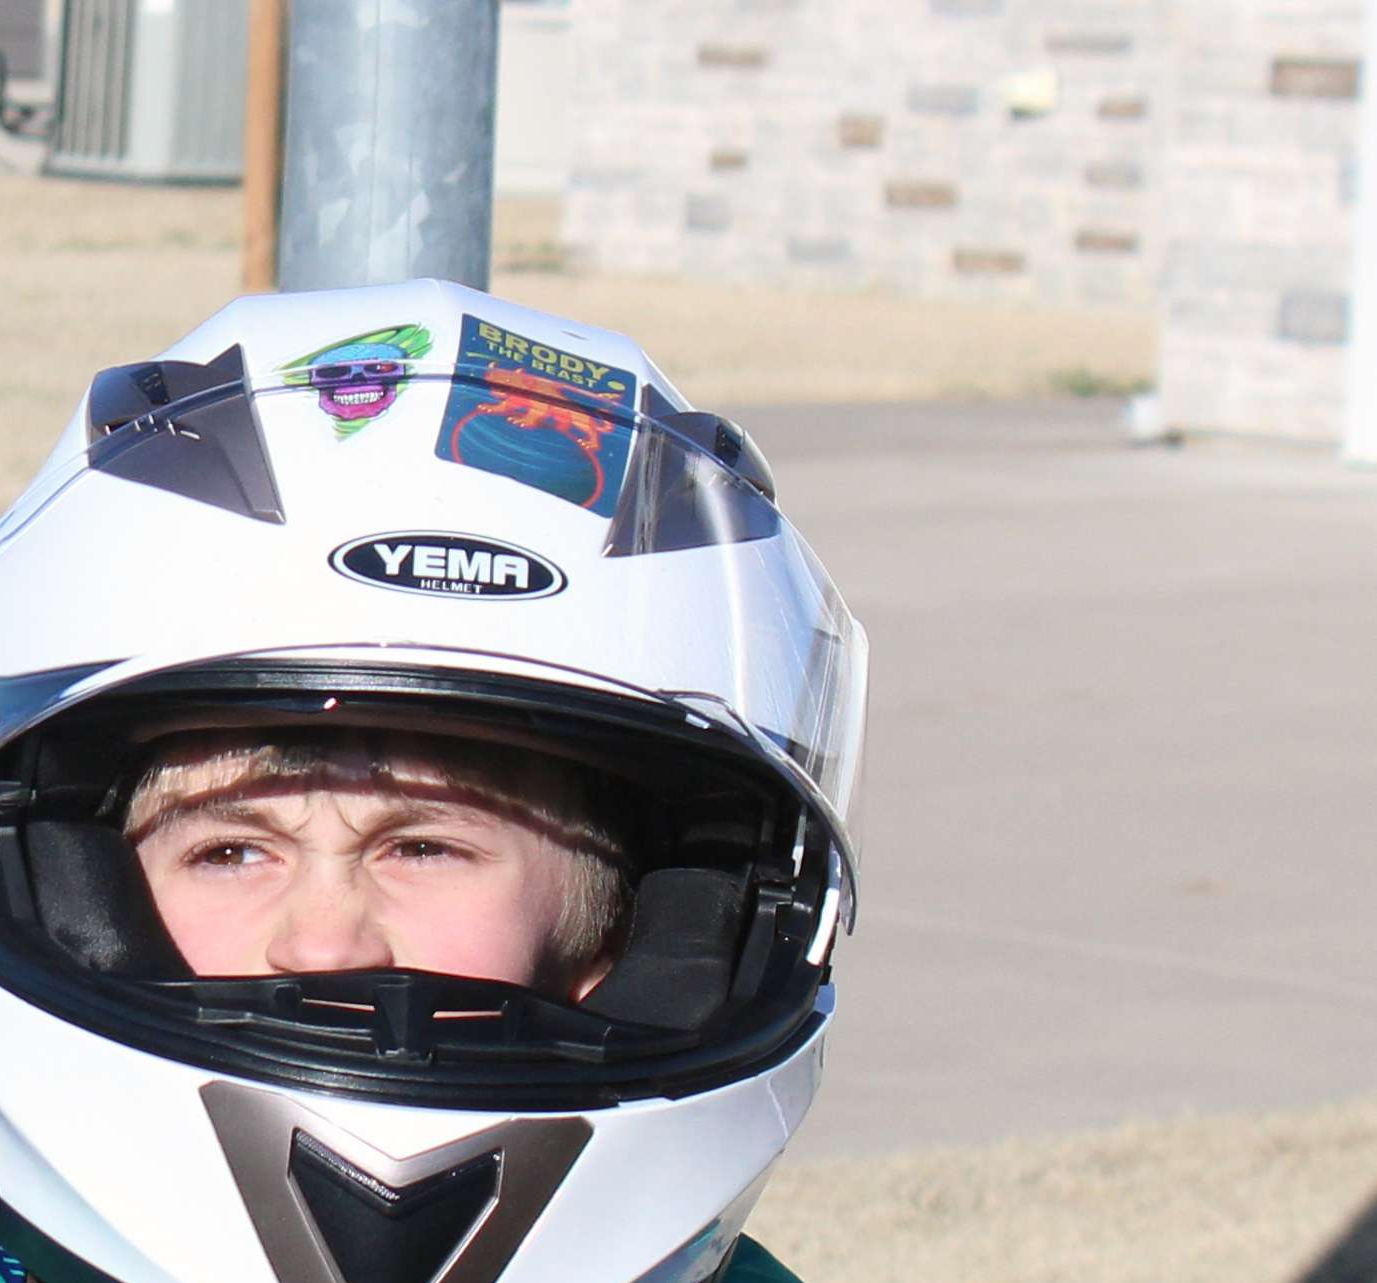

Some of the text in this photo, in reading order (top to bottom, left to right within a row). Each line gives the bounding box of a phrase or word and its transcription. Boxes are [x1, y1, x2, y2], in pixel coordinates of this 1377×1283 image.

[478, 322, 610, 380] BRODY
[486, 340, 598, 389] THE BEAST
[373, 543, 529, 589] YEMA
[420, 579, 484, 594] HELMET
